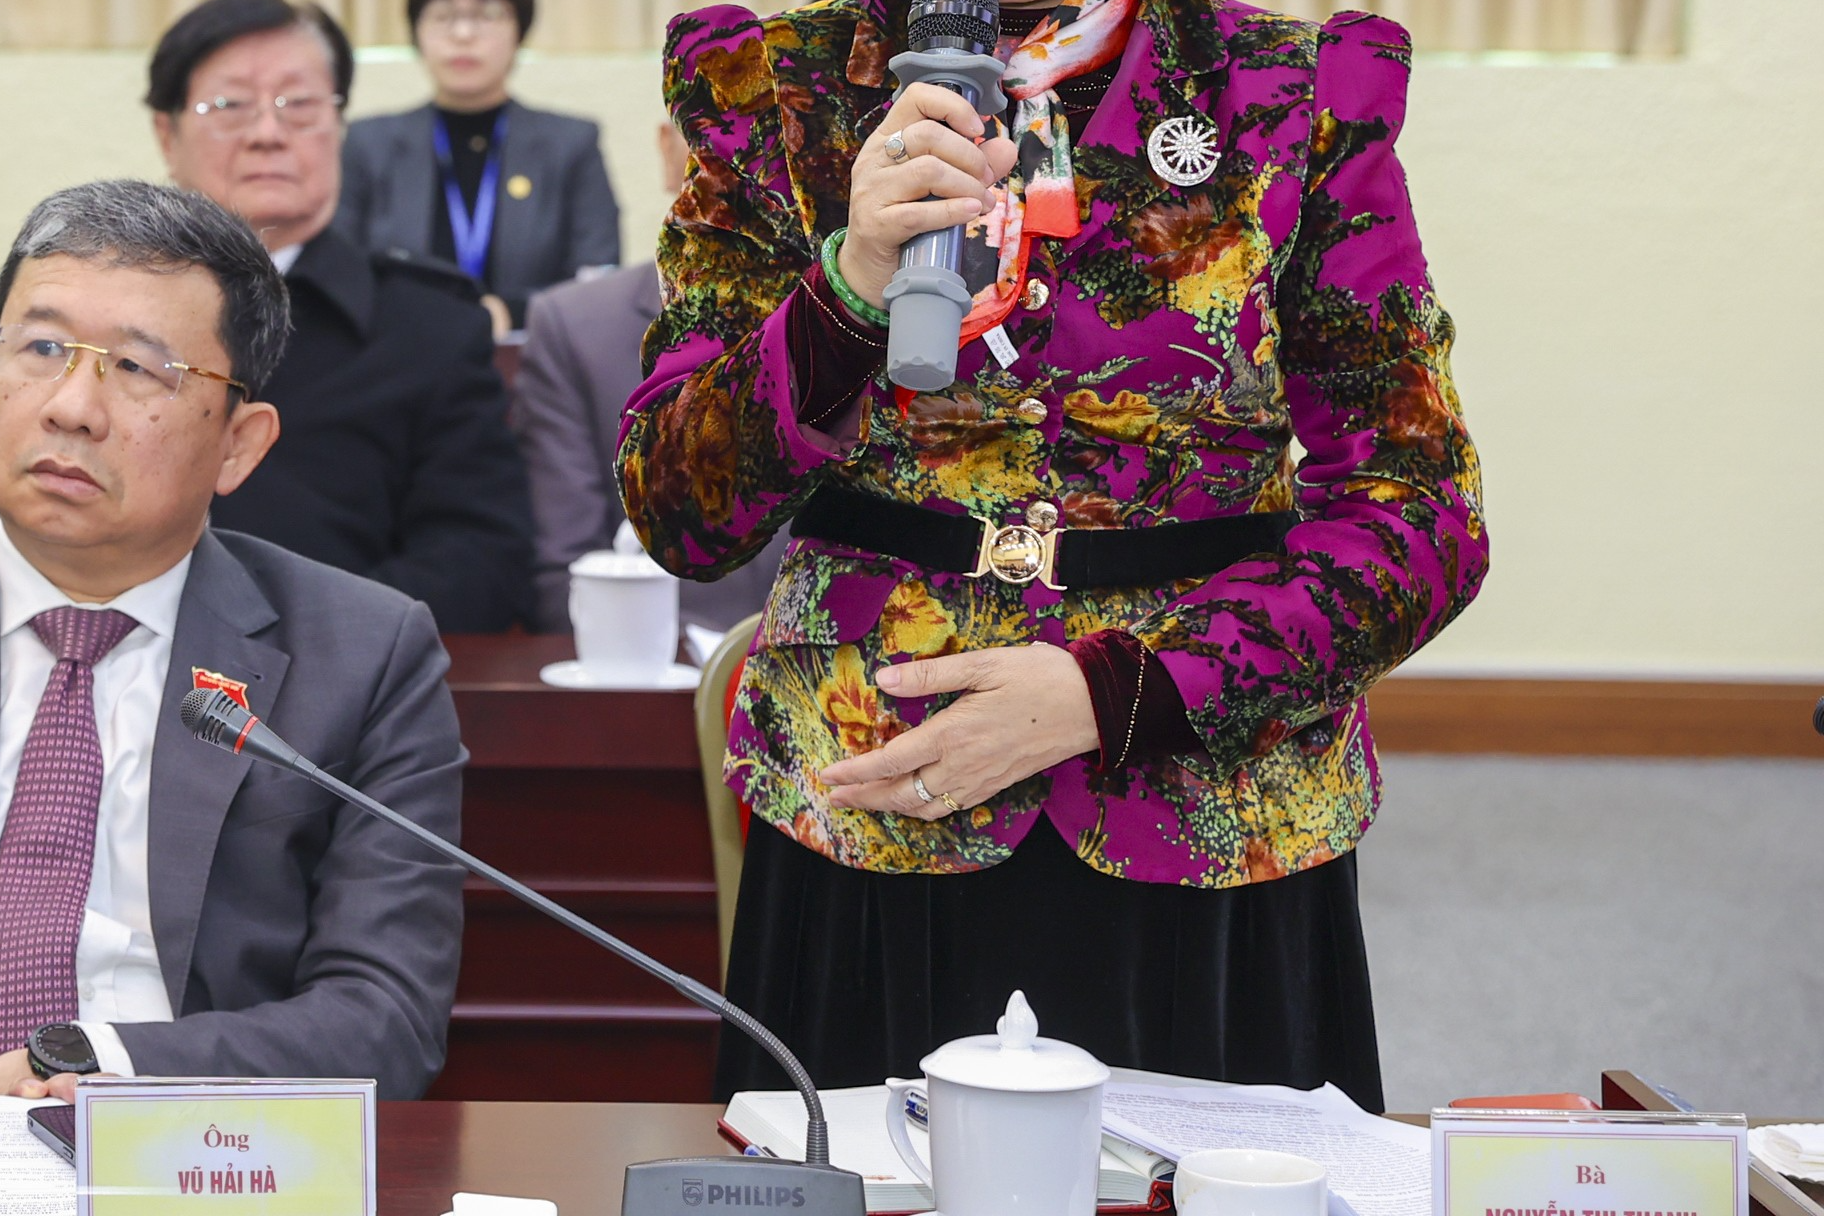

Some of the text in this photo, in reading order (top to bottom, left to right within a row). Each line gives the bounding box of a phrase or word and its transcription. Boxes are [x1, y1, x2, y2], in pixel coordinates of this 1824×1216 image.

[203, 1123, 250, 1153] Ông
[177, 1162, 277, 1195] VŨ HẢI HÀ
[1575, 1164, 1607, 1185] Bà
[708, 1184, 806, 1208] PHILIPS
